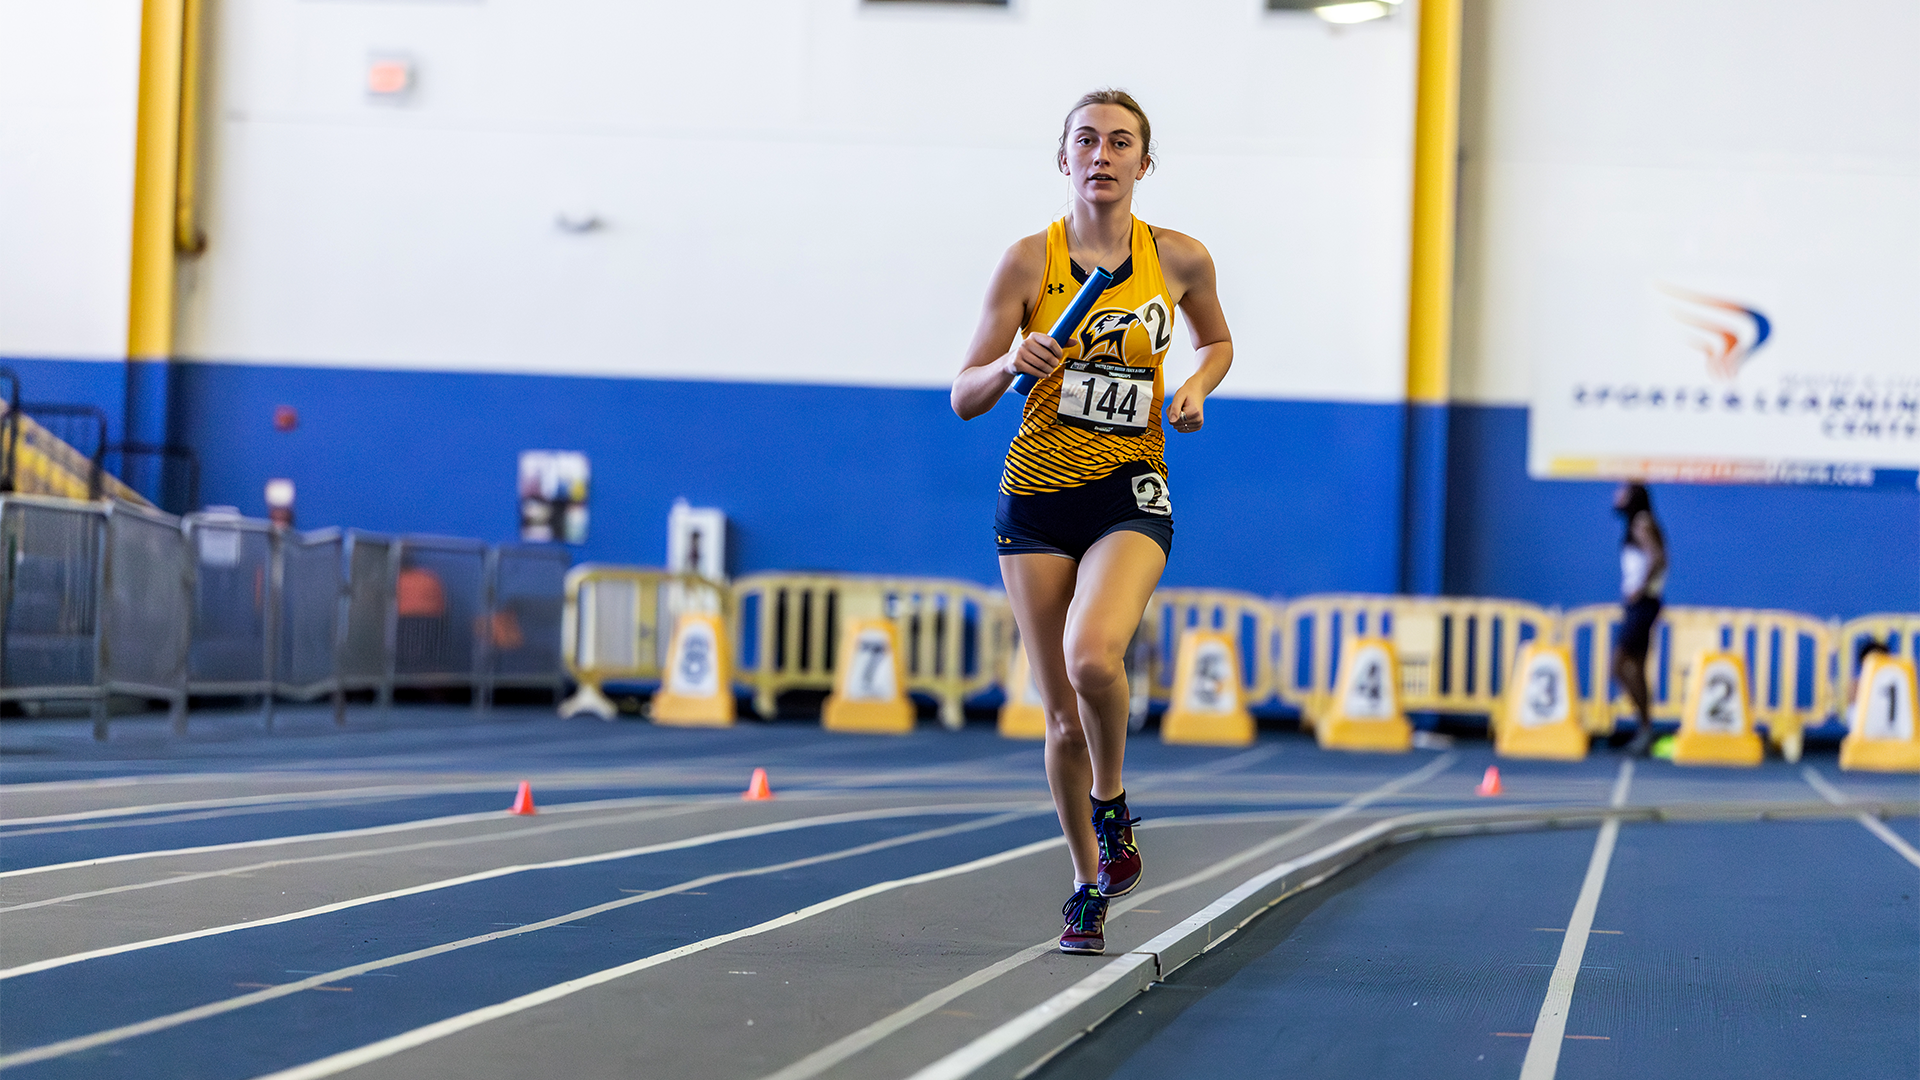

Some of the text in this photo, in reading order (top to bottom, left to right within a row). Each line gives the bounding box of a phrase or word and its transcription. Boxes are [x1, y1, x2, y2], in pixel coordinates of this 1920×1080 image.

[1143, 303, 1170, 350] 2
[1081, 377, 1138, 423] 144
[1136, 476, 1168, 512] 2
[682, 634, 710, 685] 8
[860, 639, 888, 692] 7
[1356, 662, 1385, 703] 4
[1530, 667, 1556, 716] 3
[1706, 674, 1735, 726] 2
[1881, 683, 1897, 726] 1
